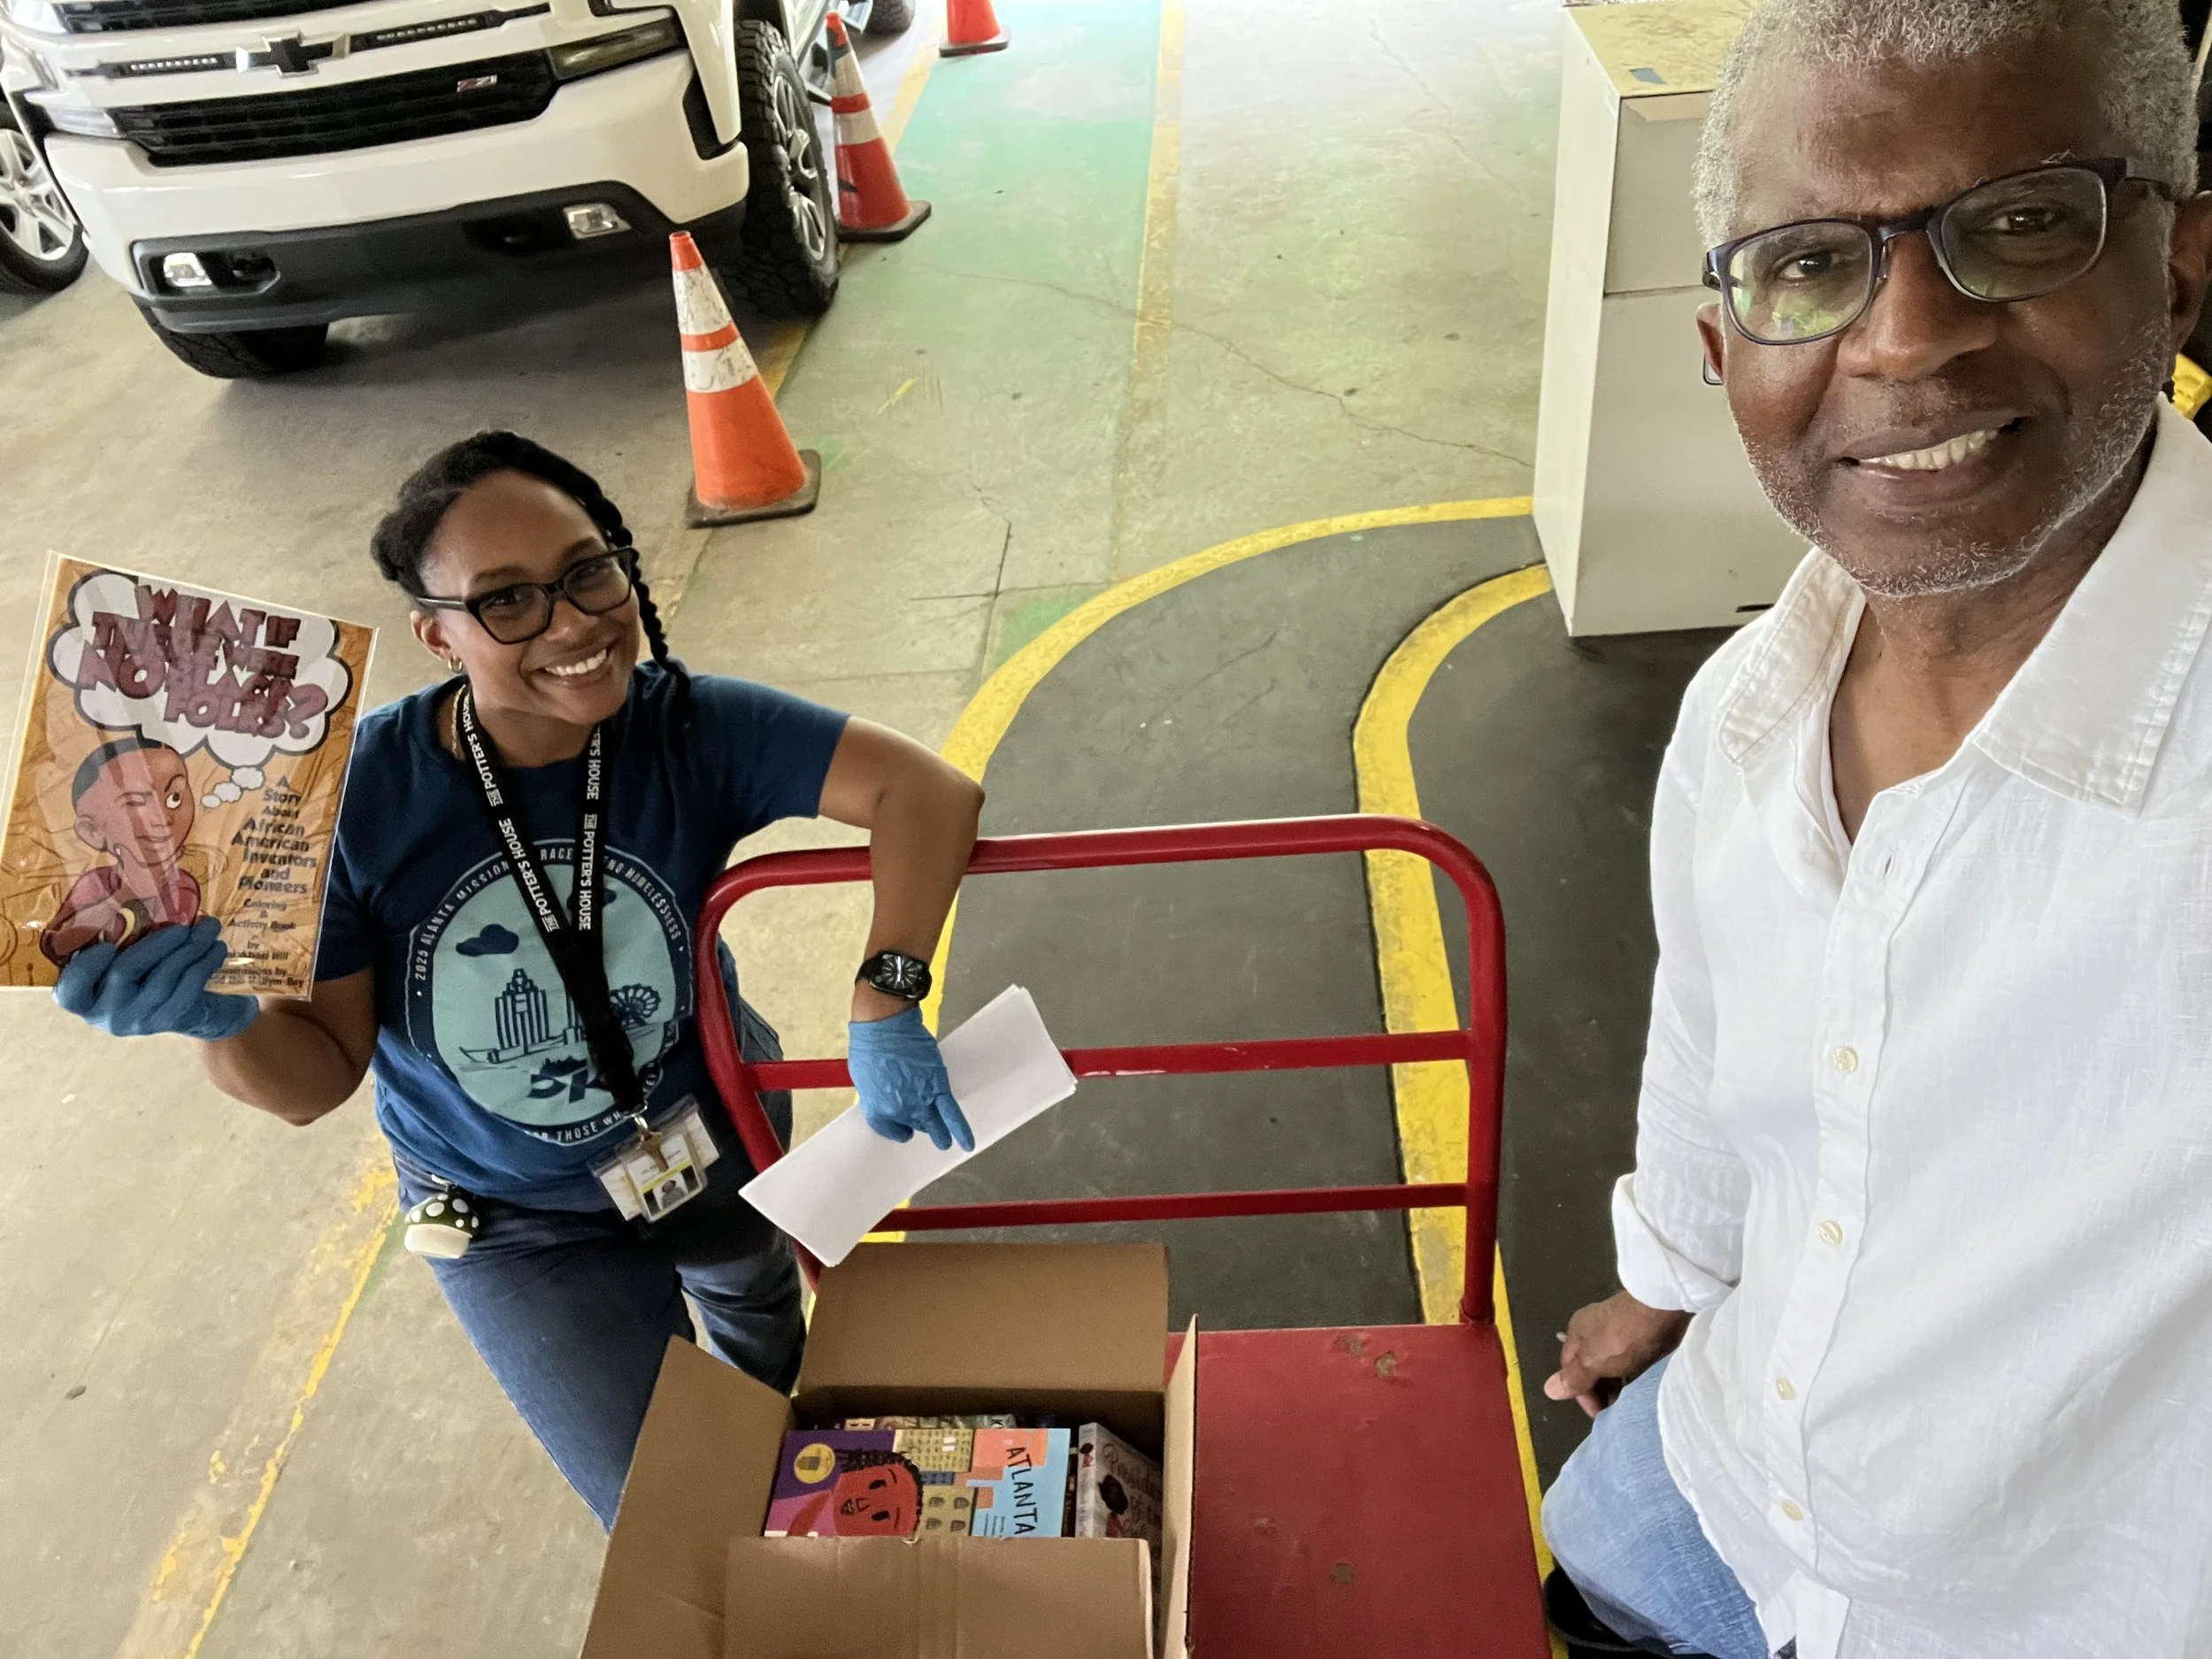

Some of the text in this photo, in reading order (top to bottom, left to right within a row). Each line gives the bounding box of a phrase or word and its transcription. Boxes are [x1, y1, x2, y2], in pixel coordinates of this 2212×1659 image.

[134, 585, 267, 647] WHAT
[76, 641, 166, 700] NO
[462, 693, 474, 733] HOU
[467, 733, 496, 789] POTTER'S
[587, 759, 602, 800] HOUSE
[231, 832, 310, 852] American
[242, 817, 305, 836] African
[498, 818, 526, 860] HOUSE
[243, 849, 318, 868] Inventors
[261, 866, 290, 879] and
[579, 814, 597, 931] THE POTTER'S HOUSE
[518, 860, 552, 916] POTTER'S
[415, 949, 429, 981] 2025
[456, 860, 511, 902] MISSION
[540, 847, 574, 862] RACE
[624, 867, 681, 941] HOMELESSNESS
[557, 1120, 599, 1143] THOSE
[1005, 1446, 1038, 1536] ATLANTA
